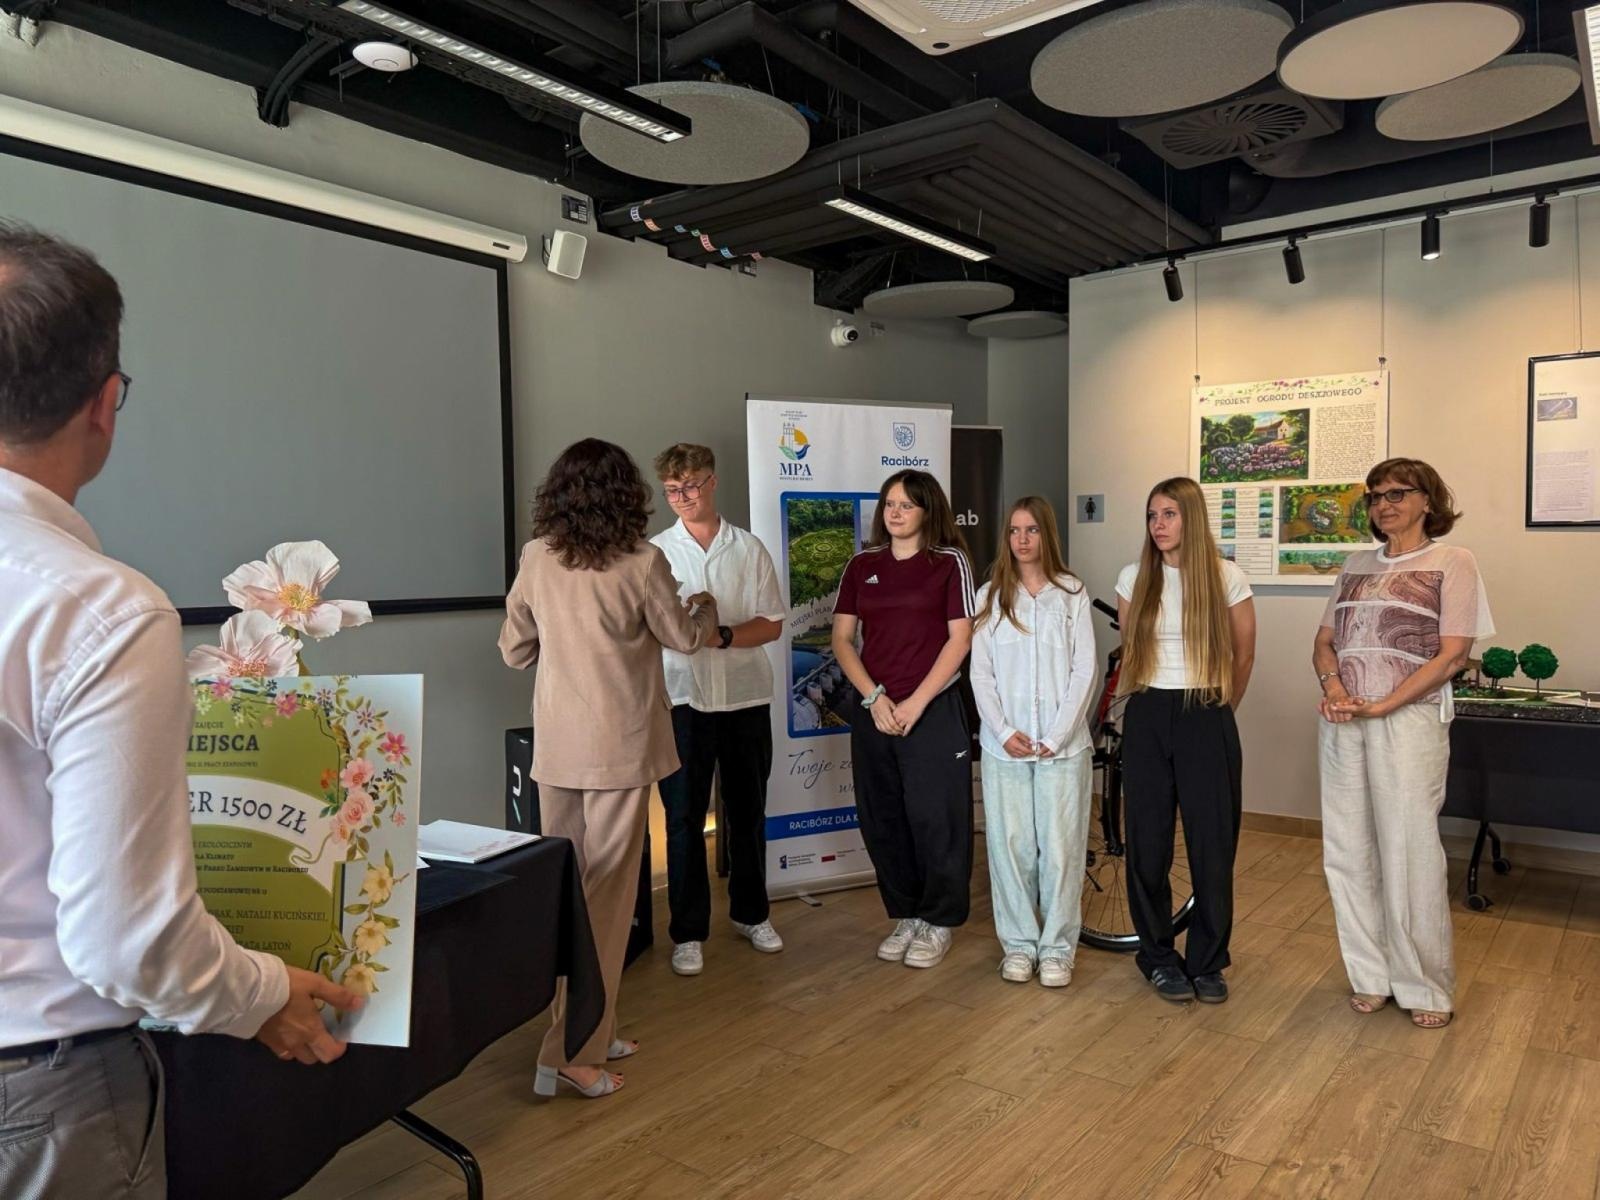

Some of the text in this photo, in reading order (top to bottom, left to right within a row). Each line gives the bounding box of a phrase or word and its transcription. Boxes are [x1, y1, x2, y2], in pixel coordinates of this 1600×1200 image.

[1214, 387, 1362, 406] PROJEKT OGRODU DESZCZOWEGO
[779, 462, 812, 476] MPA
[881, 455, 929, 467] Racibórz
[954, 508, 979, 526] ab
[187, 734, 260, 755] IEJSCA
[788, 749, 833, 790] Twoje
[189, 790, 308, 834] ER 1500 ZŁ
[789, 815, 834, 830] RACIBÓRZ
[835, 814, 852, 824] DLA
